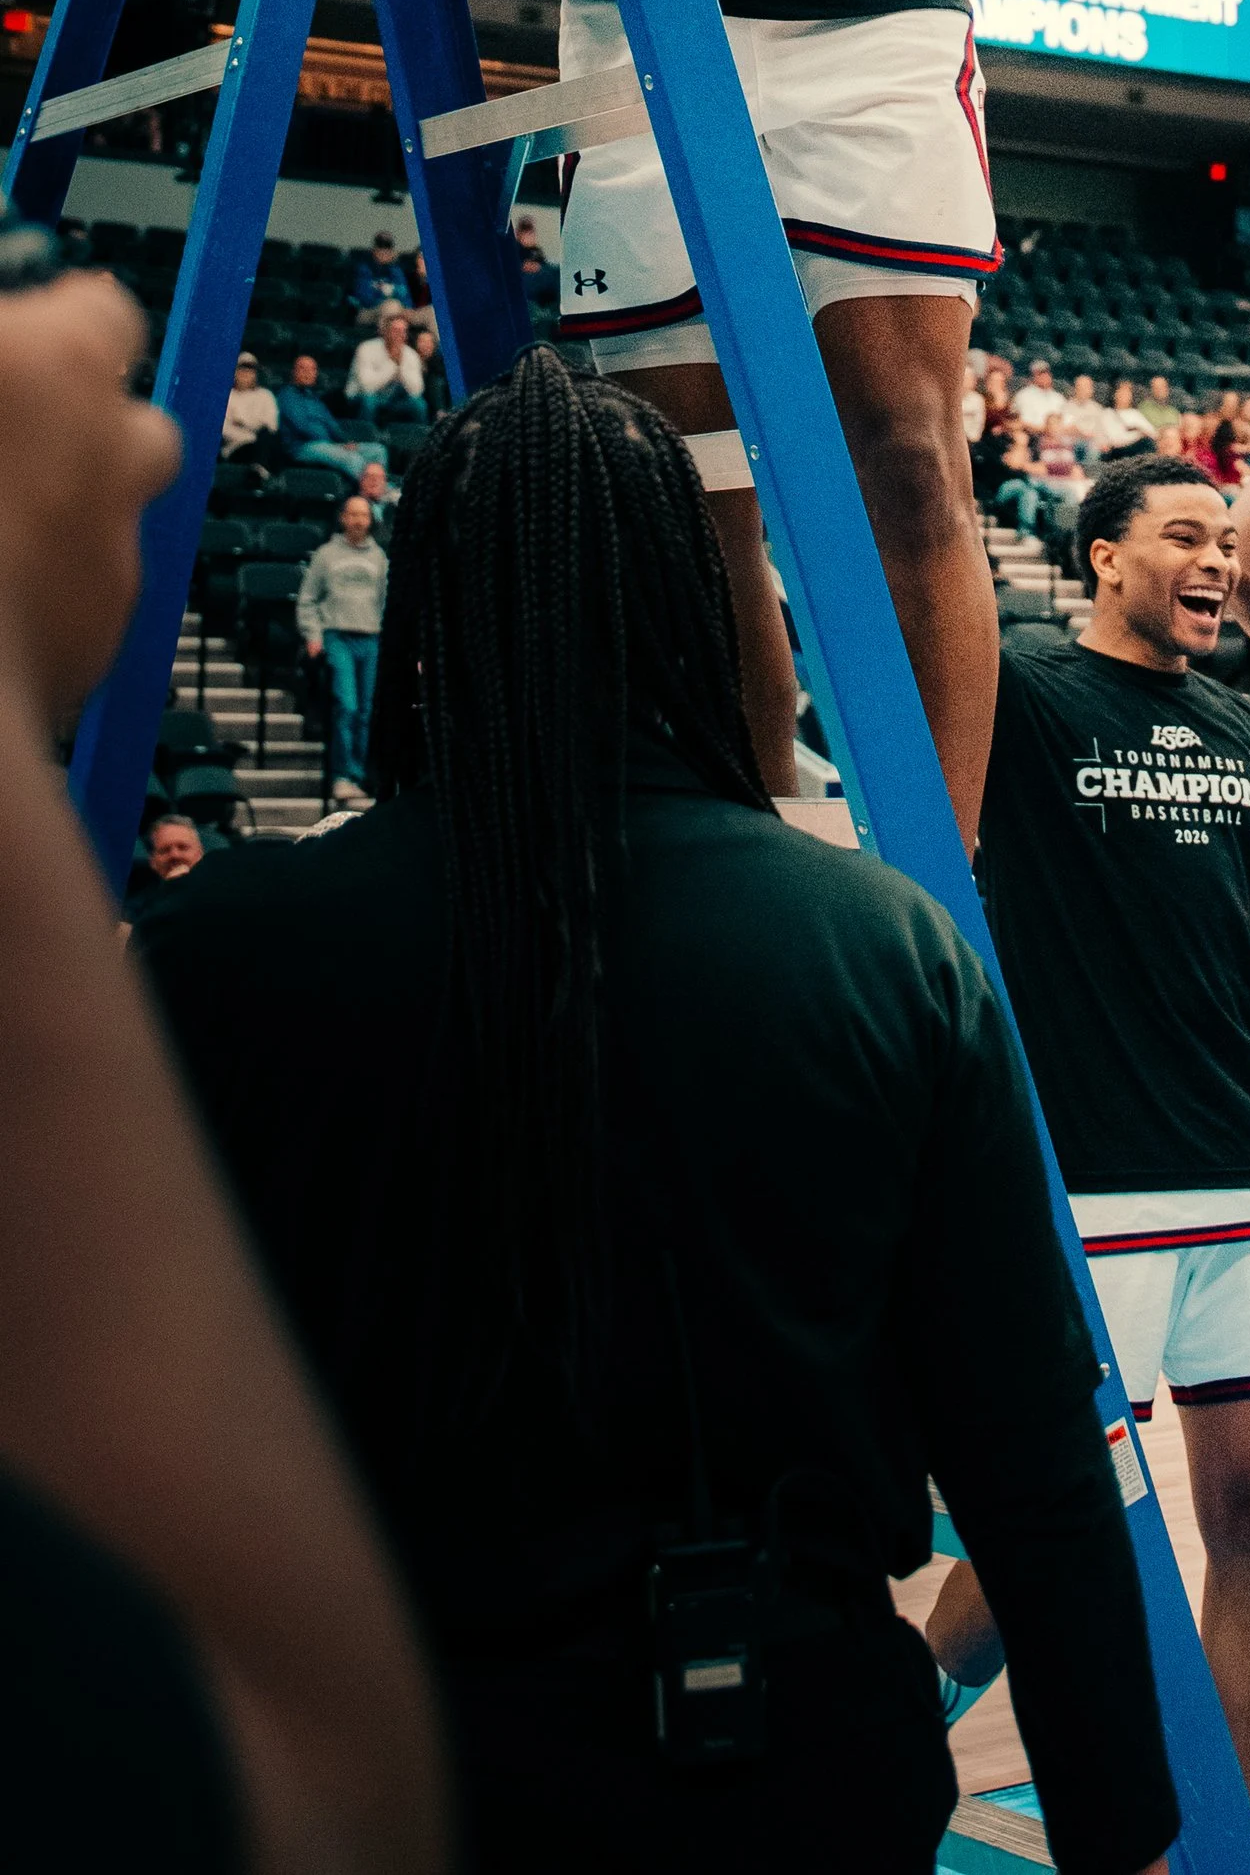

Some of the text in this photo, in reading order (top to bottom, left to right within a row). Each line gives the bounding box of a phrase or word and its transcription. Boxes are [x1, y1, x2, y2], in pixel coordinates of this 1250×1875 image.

[1114, 749, 1246, 773] TOURNAMENT
[1131, 804, 1243, 825] BASKETBALL
[1174, 828, 1210, 845] 2026
